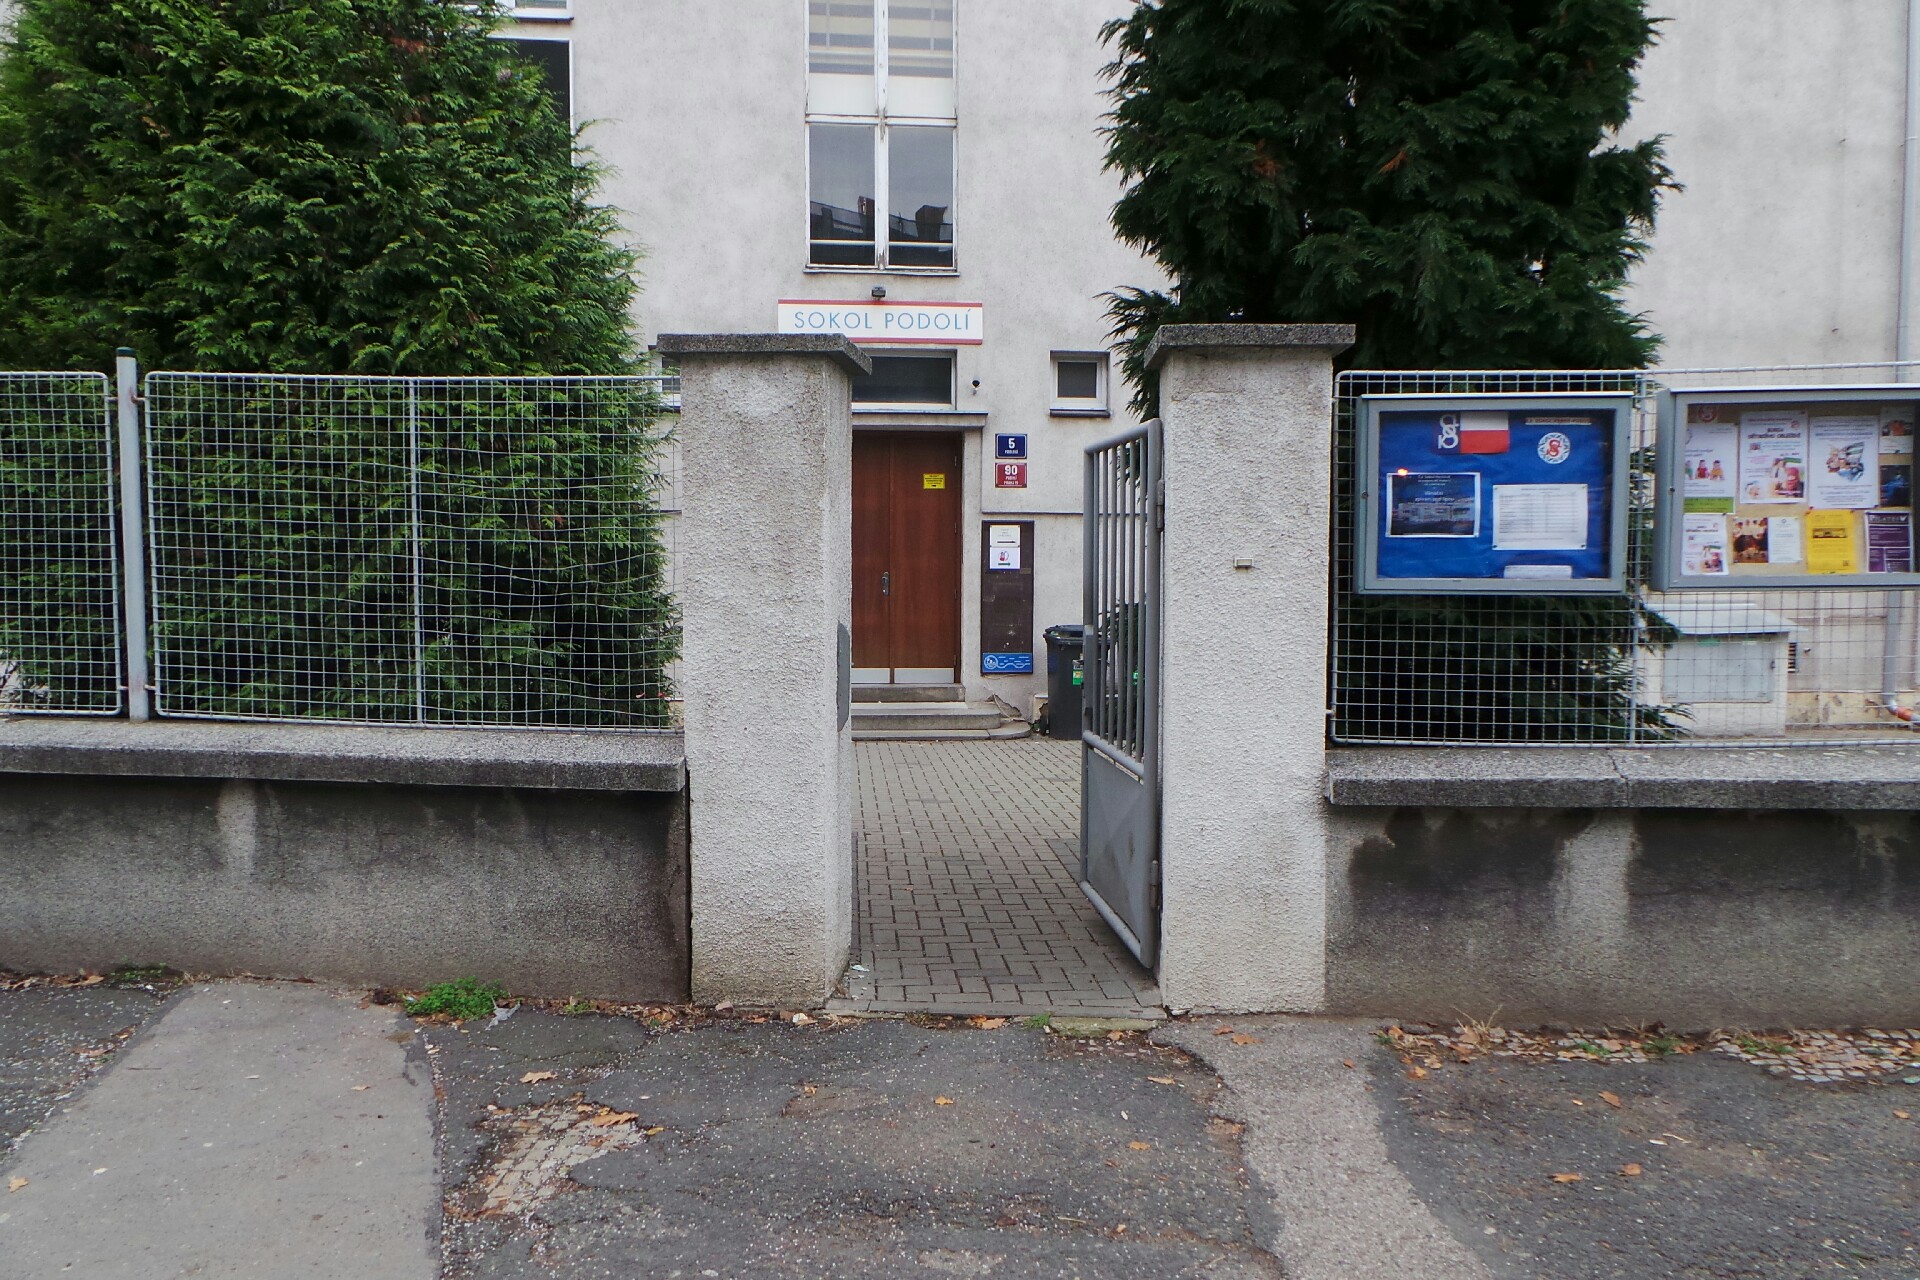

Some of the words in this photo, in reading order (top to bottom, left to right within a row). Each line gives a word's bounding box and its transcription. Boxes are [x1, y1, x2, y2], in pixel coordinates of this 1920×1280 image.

[794, 311, 872, 329] SOKOL
[885, 309, 971, 330] PODOLÍ
[1008, 437, 1016, 449] 5
[1004, 464, 1018, 475] 90
